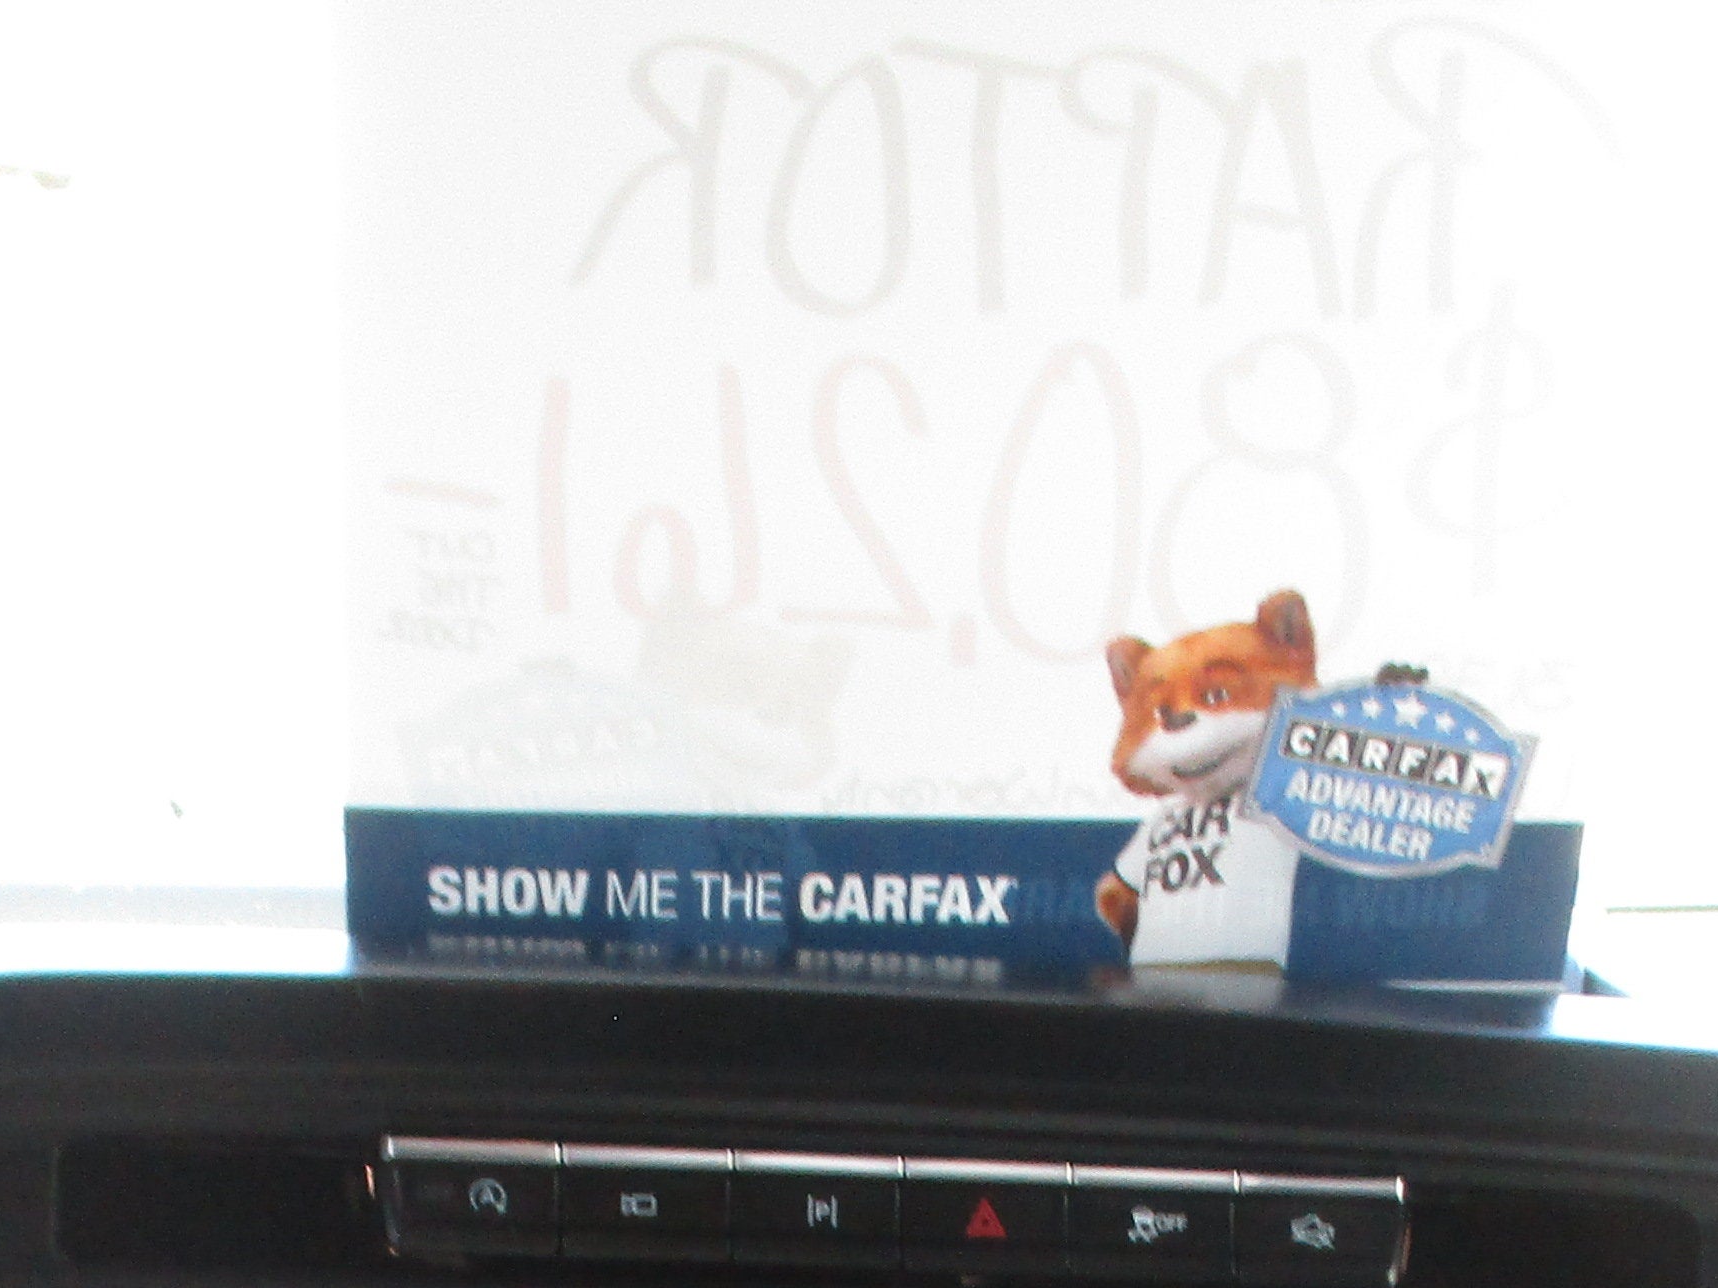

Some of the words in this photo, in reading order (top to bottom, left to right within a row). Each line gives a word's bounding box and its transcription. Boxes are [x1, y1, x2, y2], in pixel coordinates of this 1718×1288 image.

[1288, 722, 1505, 800] CARFAX
[1286, 767, 1476, 833] ADVANTAGE
[1308, 809, 1433, 860] DEALER
[427, 864, 589, 918] SHOW
[606, 868, 678, 921] ME
[691, 869, 782, 922] THE
[798, 871, 1010, 925] CARFAX
[1143, 843, 1225, 899] FOX
